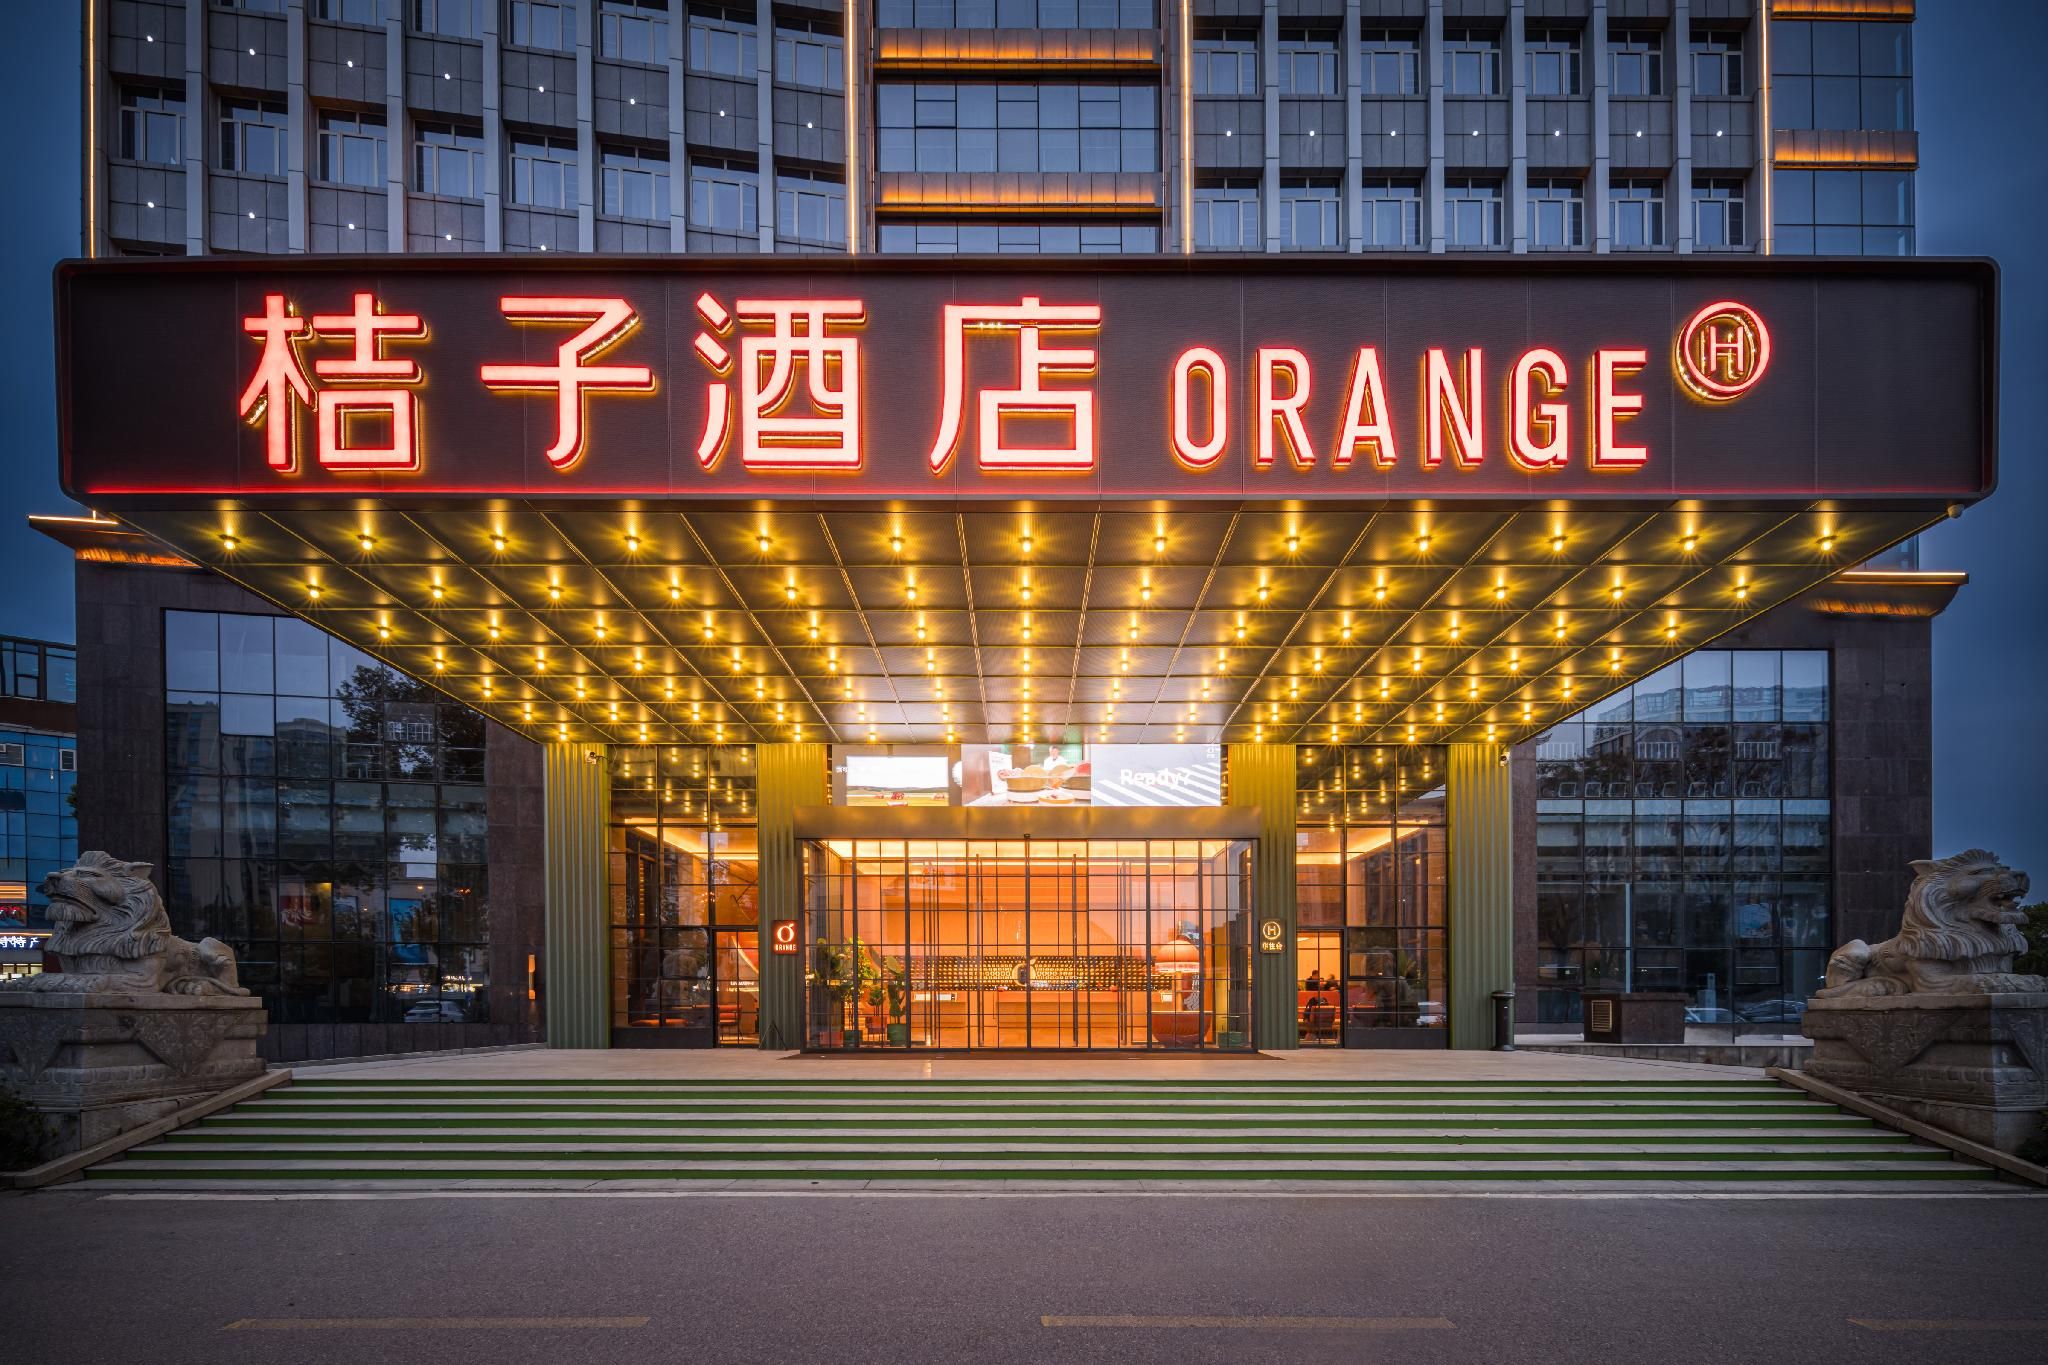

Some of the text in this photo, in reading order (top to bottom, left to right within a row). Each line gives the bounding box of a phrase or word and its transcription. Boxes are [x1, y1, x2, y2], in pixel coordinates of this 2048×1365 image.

[240, 293, 1102, 472] 桔子酒店
[1172, 346, 1649, 469] ORANGE
